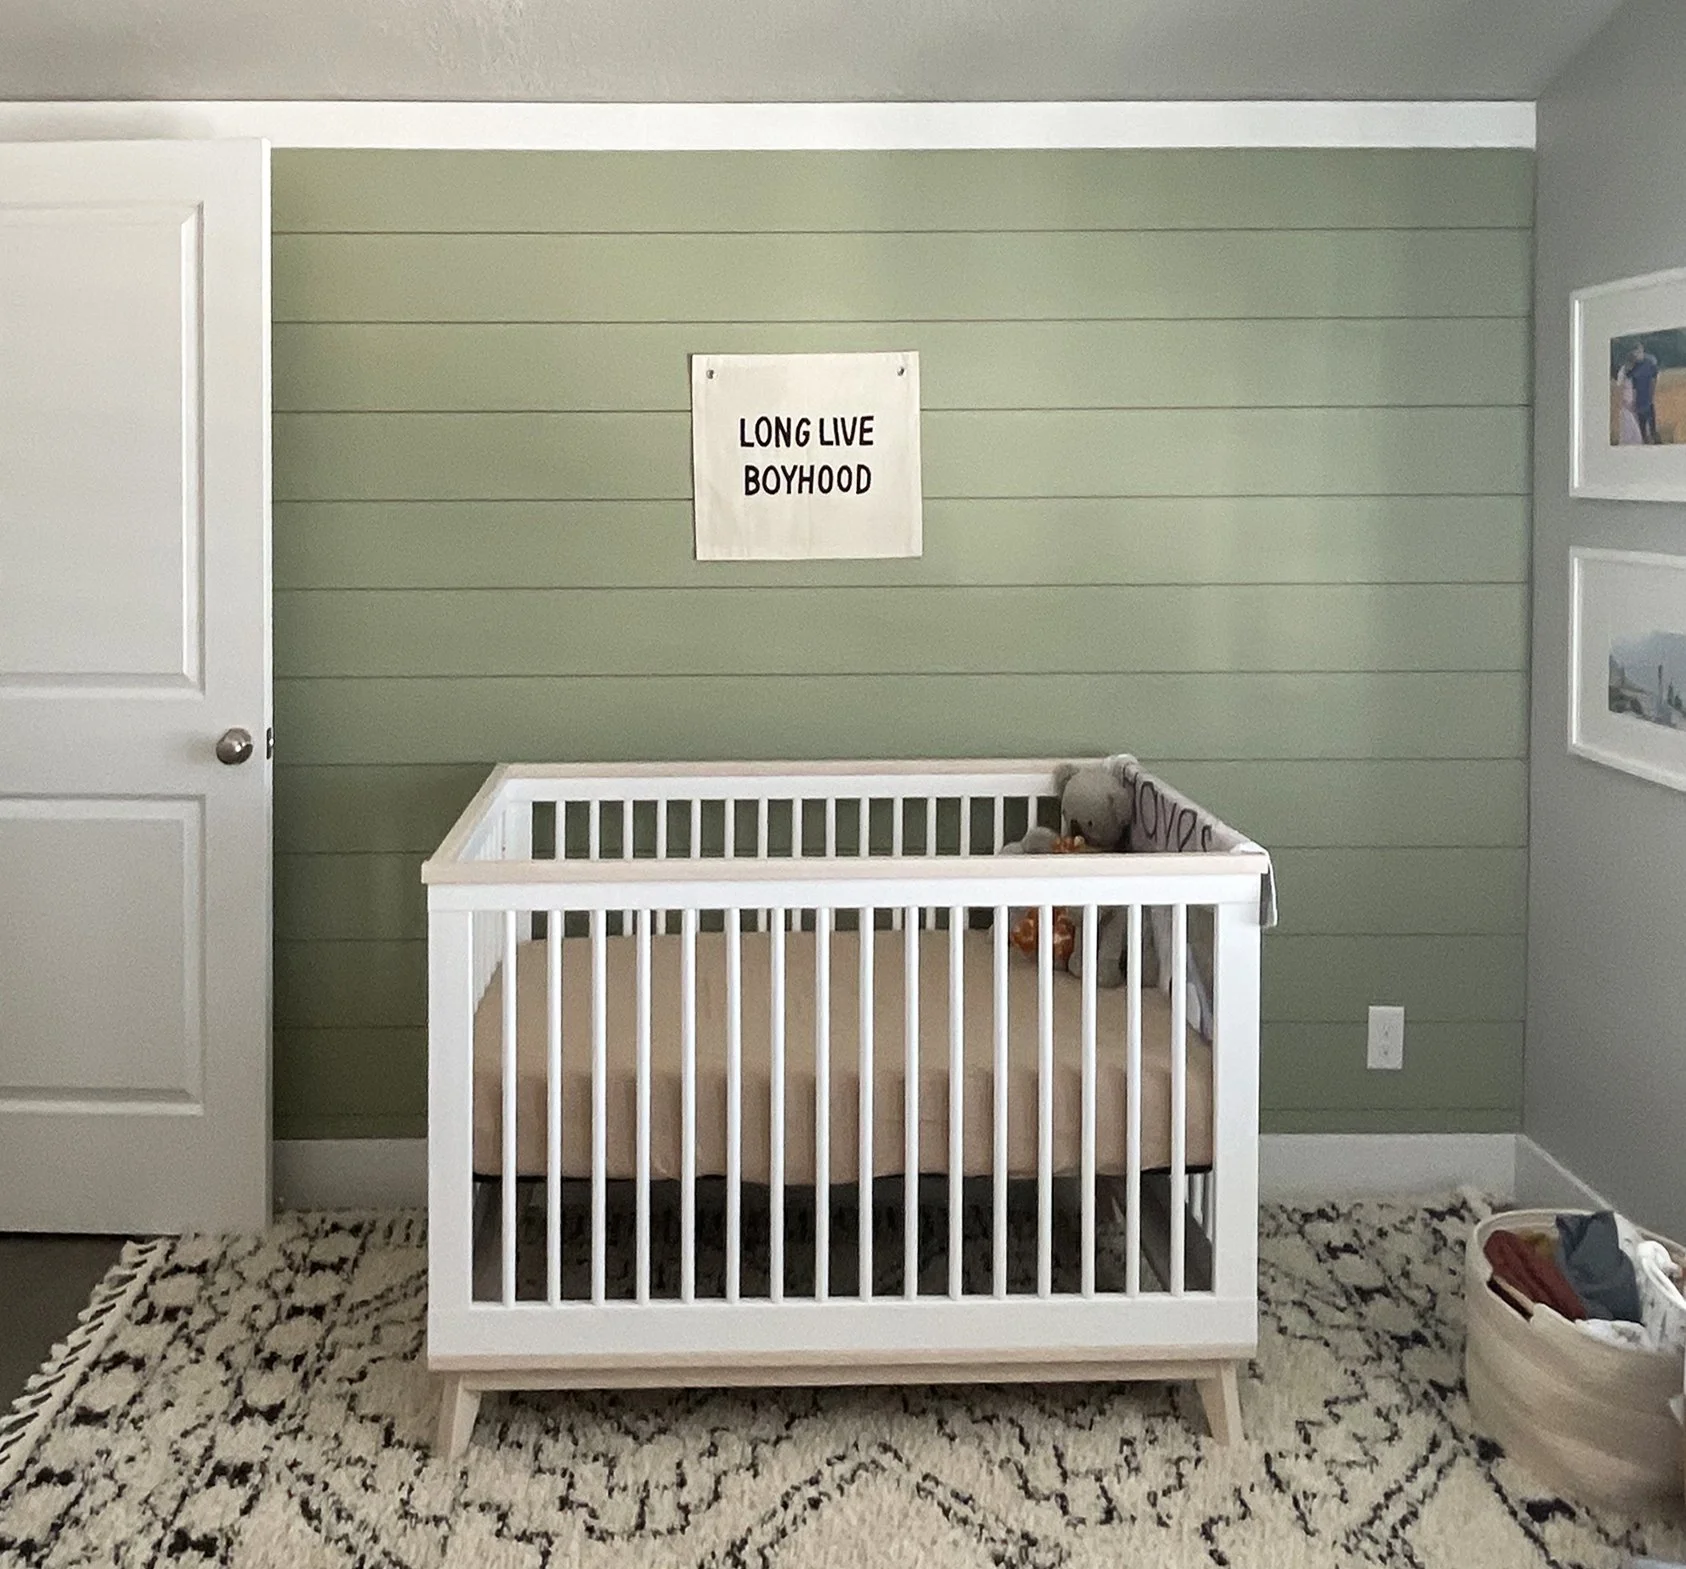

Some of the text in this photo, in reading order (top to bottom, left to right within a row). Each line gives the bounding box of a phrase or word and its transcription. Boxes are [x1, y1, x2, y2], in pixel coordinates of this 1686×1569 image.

[740, 415, 875, 448] LONG LIVE
[744, 463, 872, 496] BOYHOOD
